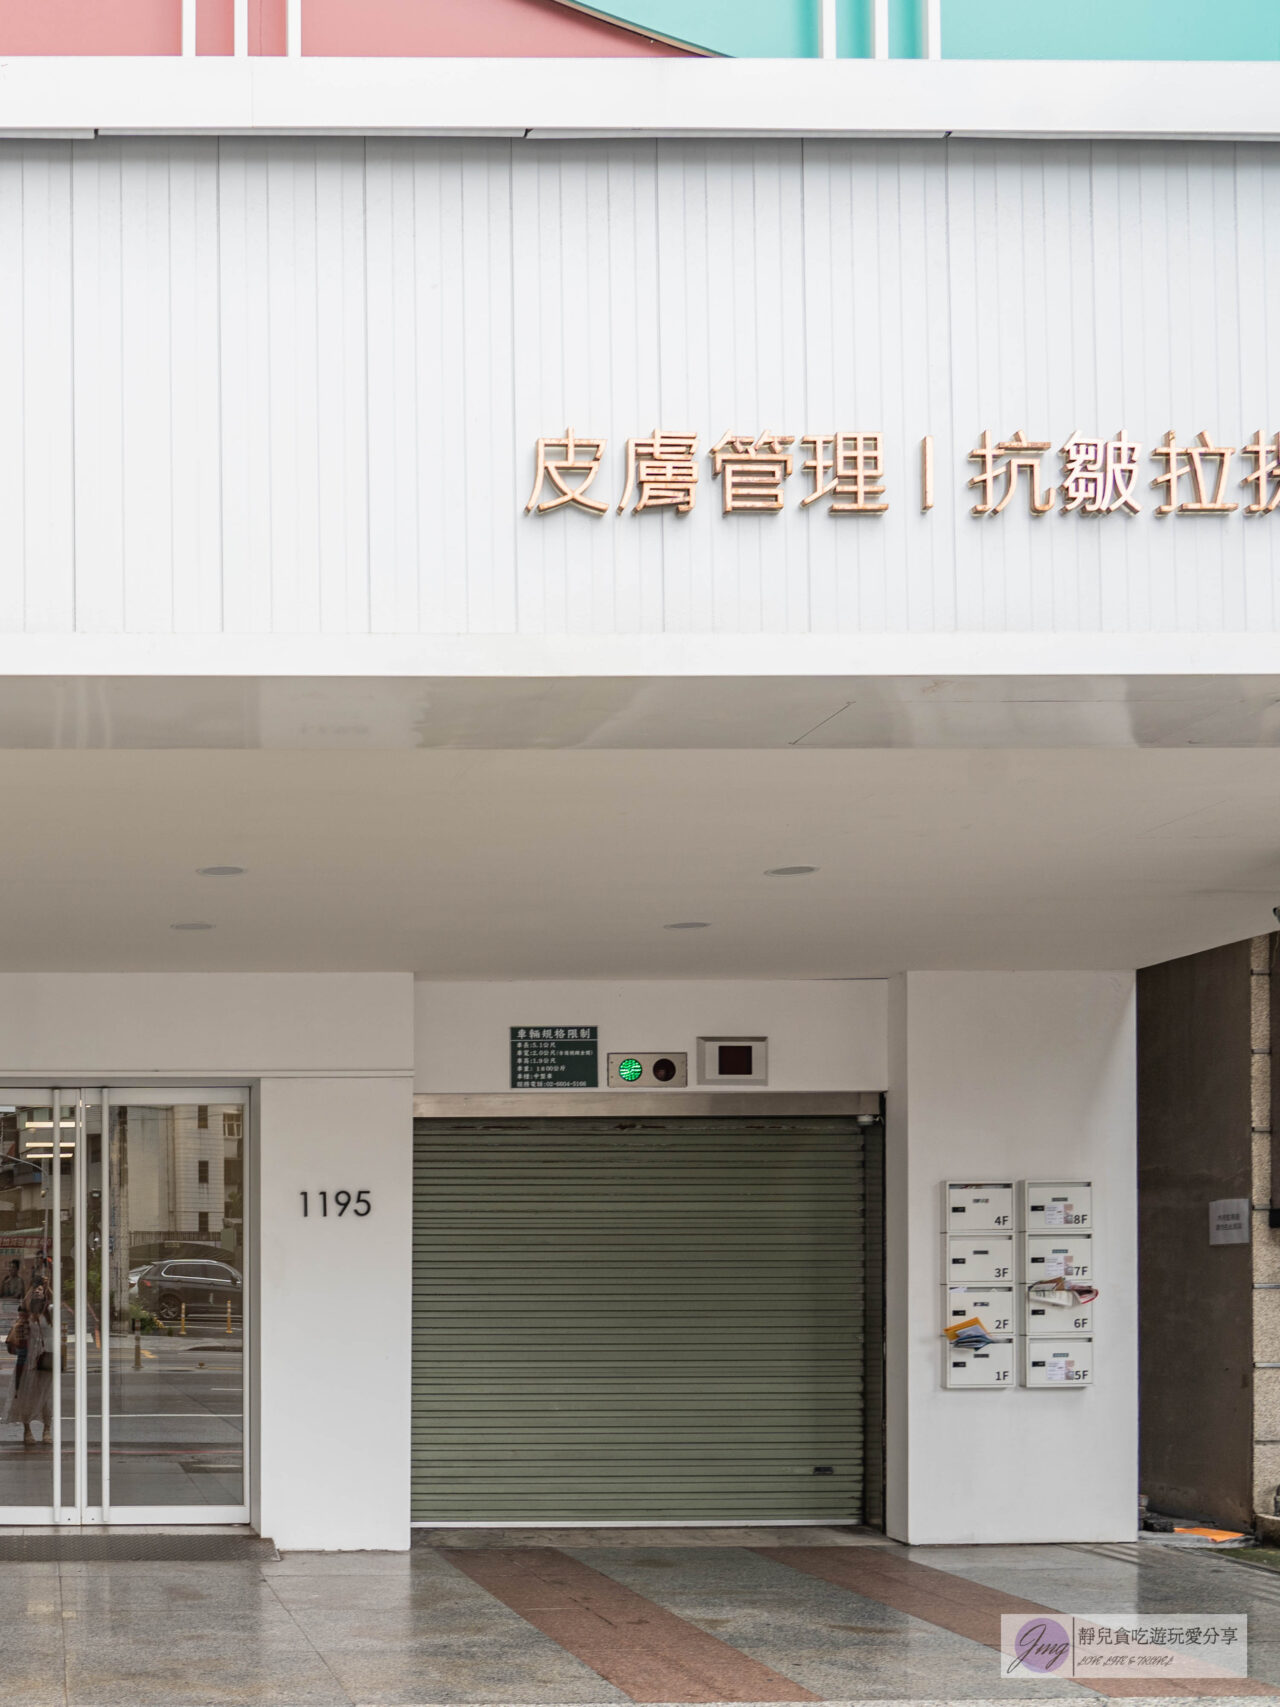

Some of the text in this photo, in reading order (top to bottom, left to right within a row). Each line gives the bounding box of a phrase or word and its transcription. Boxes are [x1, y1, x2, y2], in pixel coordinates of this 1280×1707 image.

[524, 427, 890, 517] 皮膚管理
[517, 1028, 591, 1039] 車輛規格限制
[299, 1190, 372, 1217] 1195
[994, 1215, 1009, 1226] 4F
[1073, 1214, 1088, 1225] 8F
[994, 1268, 1009, 1278] 3F
[1073, 1266, 1088, 1276] 7F
[994, 1319, 1009, 1329] 2F
[1073, 1318, 1088, 1328] 6F
[995, 1371, 1009, 1381] 1F
[1074, 1370, 1089, 1380] 5F
